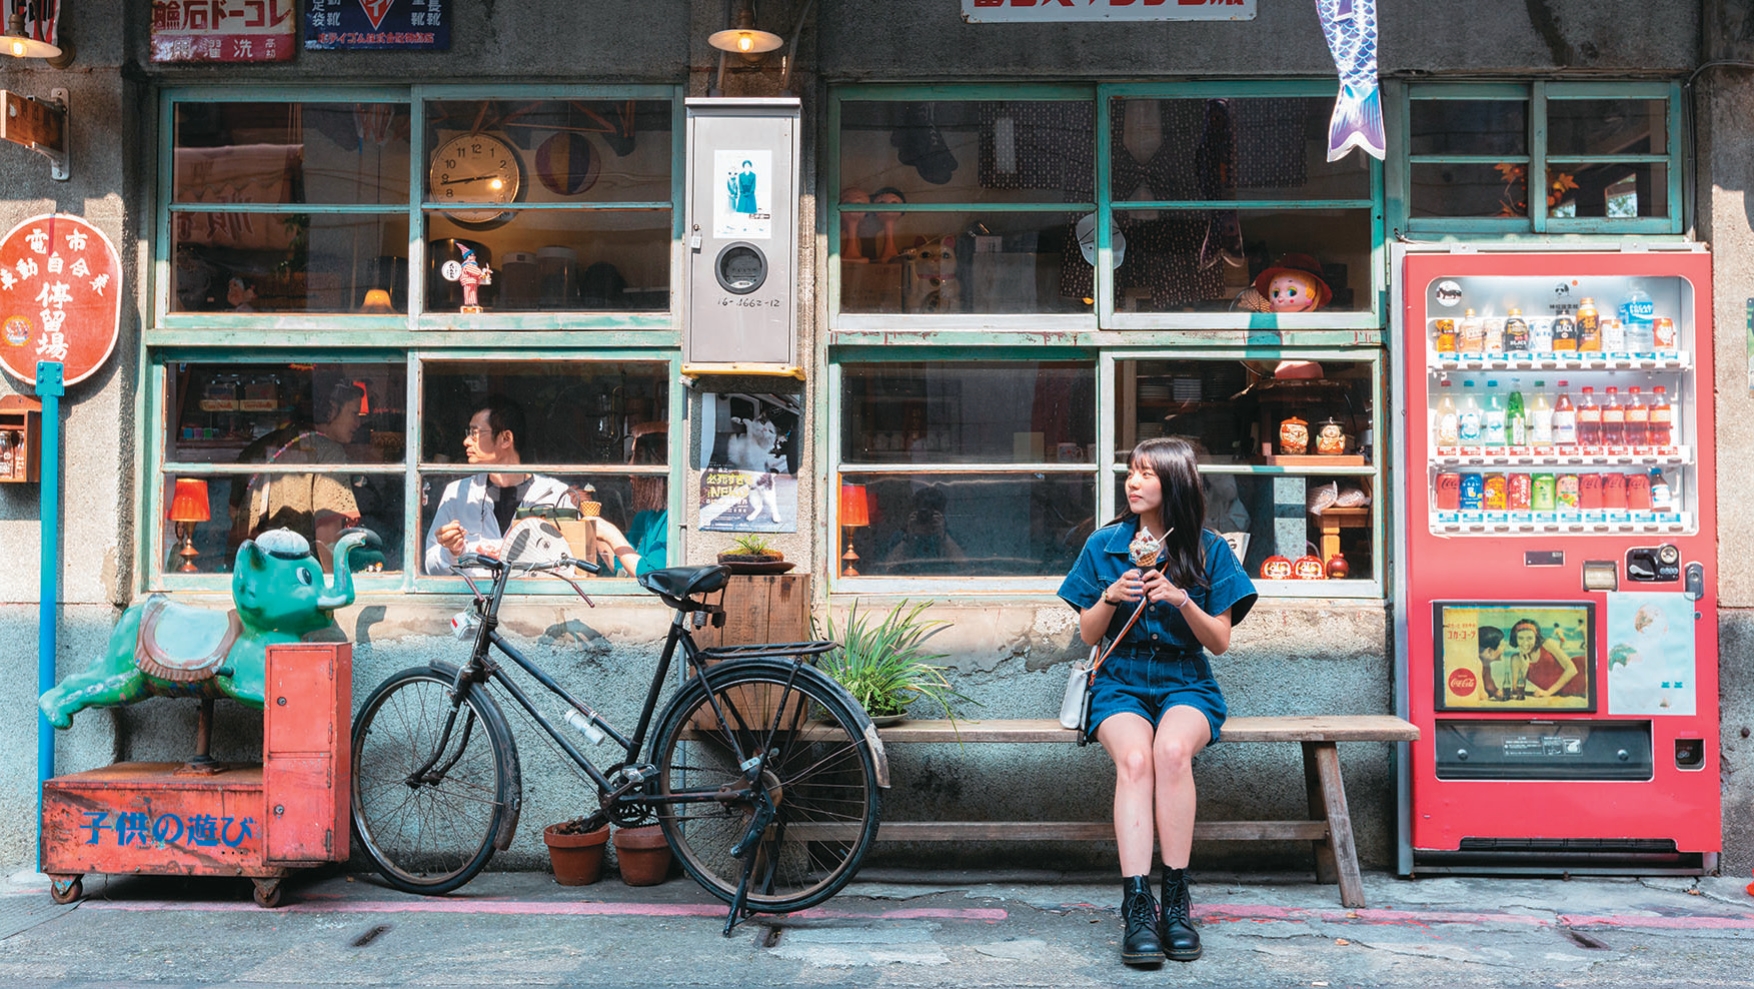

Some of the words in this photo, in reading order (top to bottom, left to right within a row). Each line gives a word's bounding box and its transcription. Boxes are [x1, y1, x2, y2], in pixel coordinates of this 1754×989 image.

[457, 148, 466, 158] 11
[471, 144, 482, 154] 12
[445, 160, 456, 169] 10
[500, 160, 507, 169] 2
[446, 189, 454, 198] 8
[35, 280, 73, 361] 停留場
[79, 811, 255, 847] 子供の遊び
